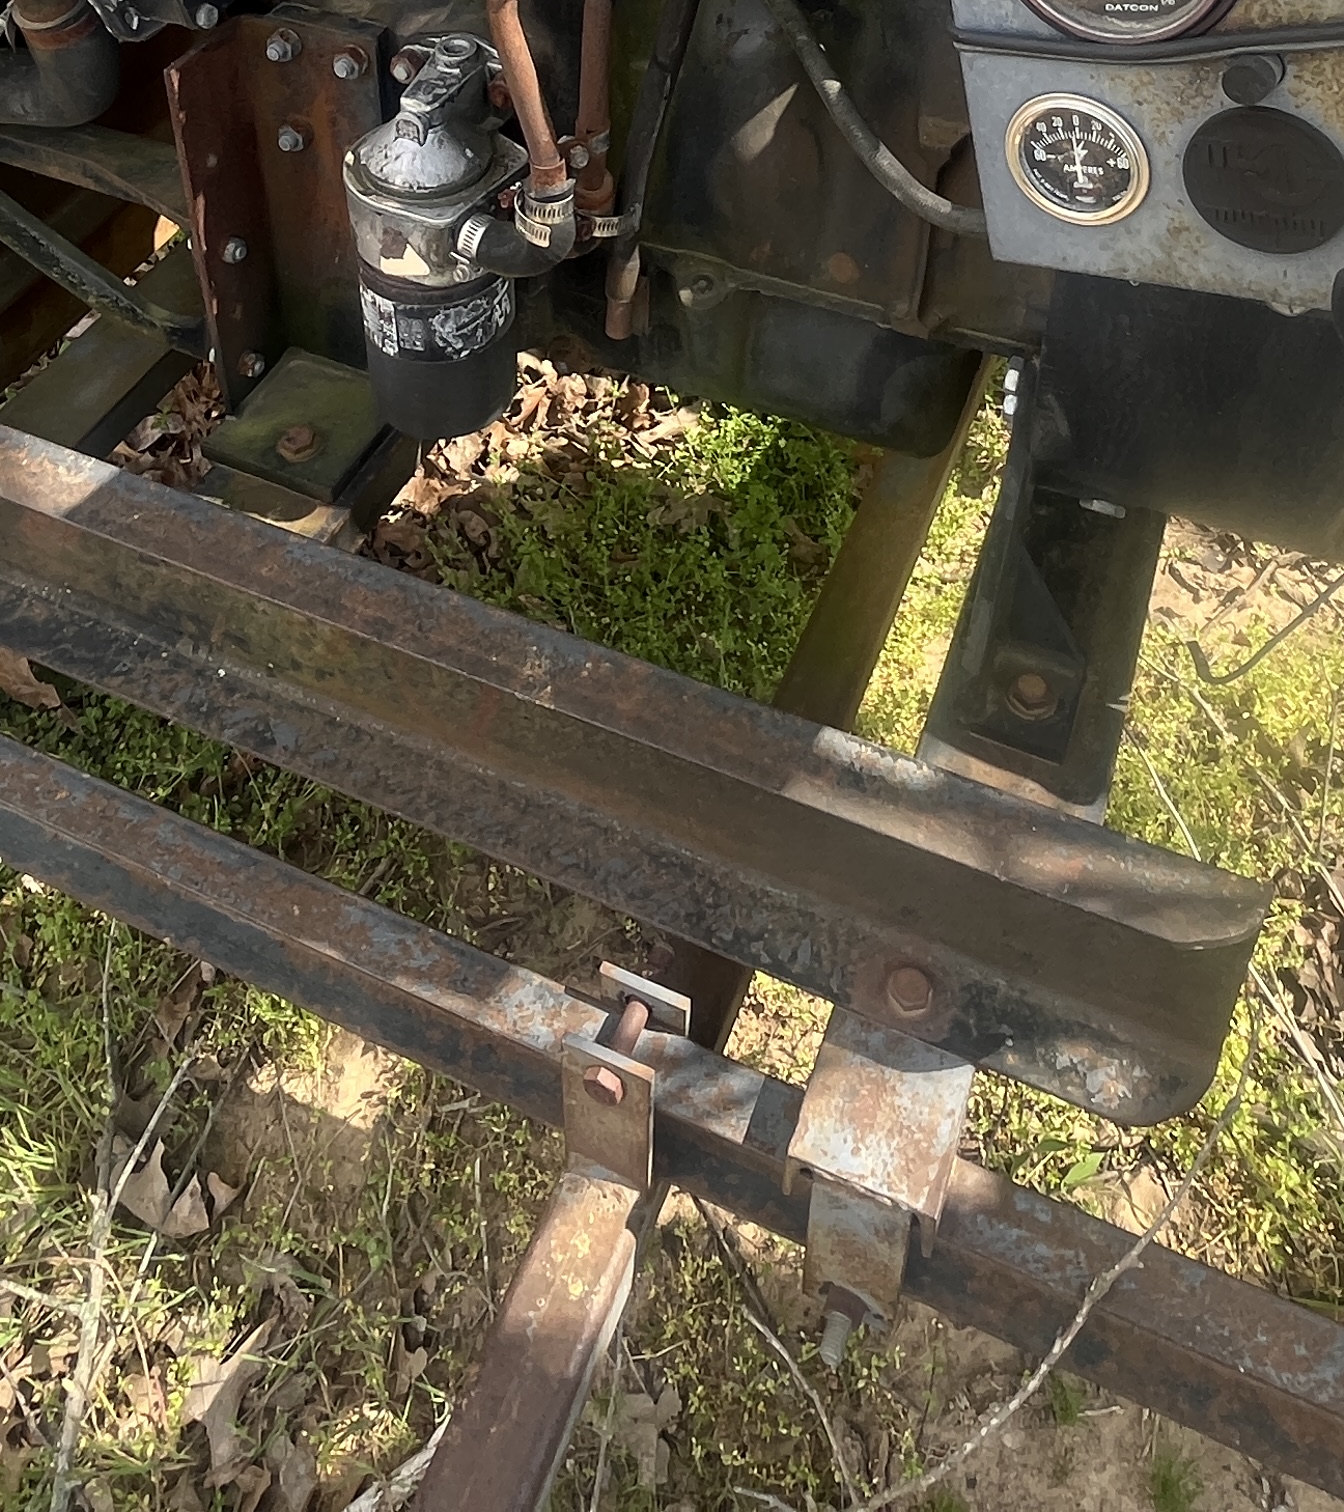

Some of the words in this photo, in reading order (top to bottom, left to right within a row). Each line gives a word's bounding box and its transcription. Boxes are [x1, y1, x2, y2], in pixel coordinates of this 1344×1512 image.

[1104, 3, 1159, 12] DATCON
[1072, 114, 1080, 126] 0
[1062, 162, 1105, 176] AMERES
